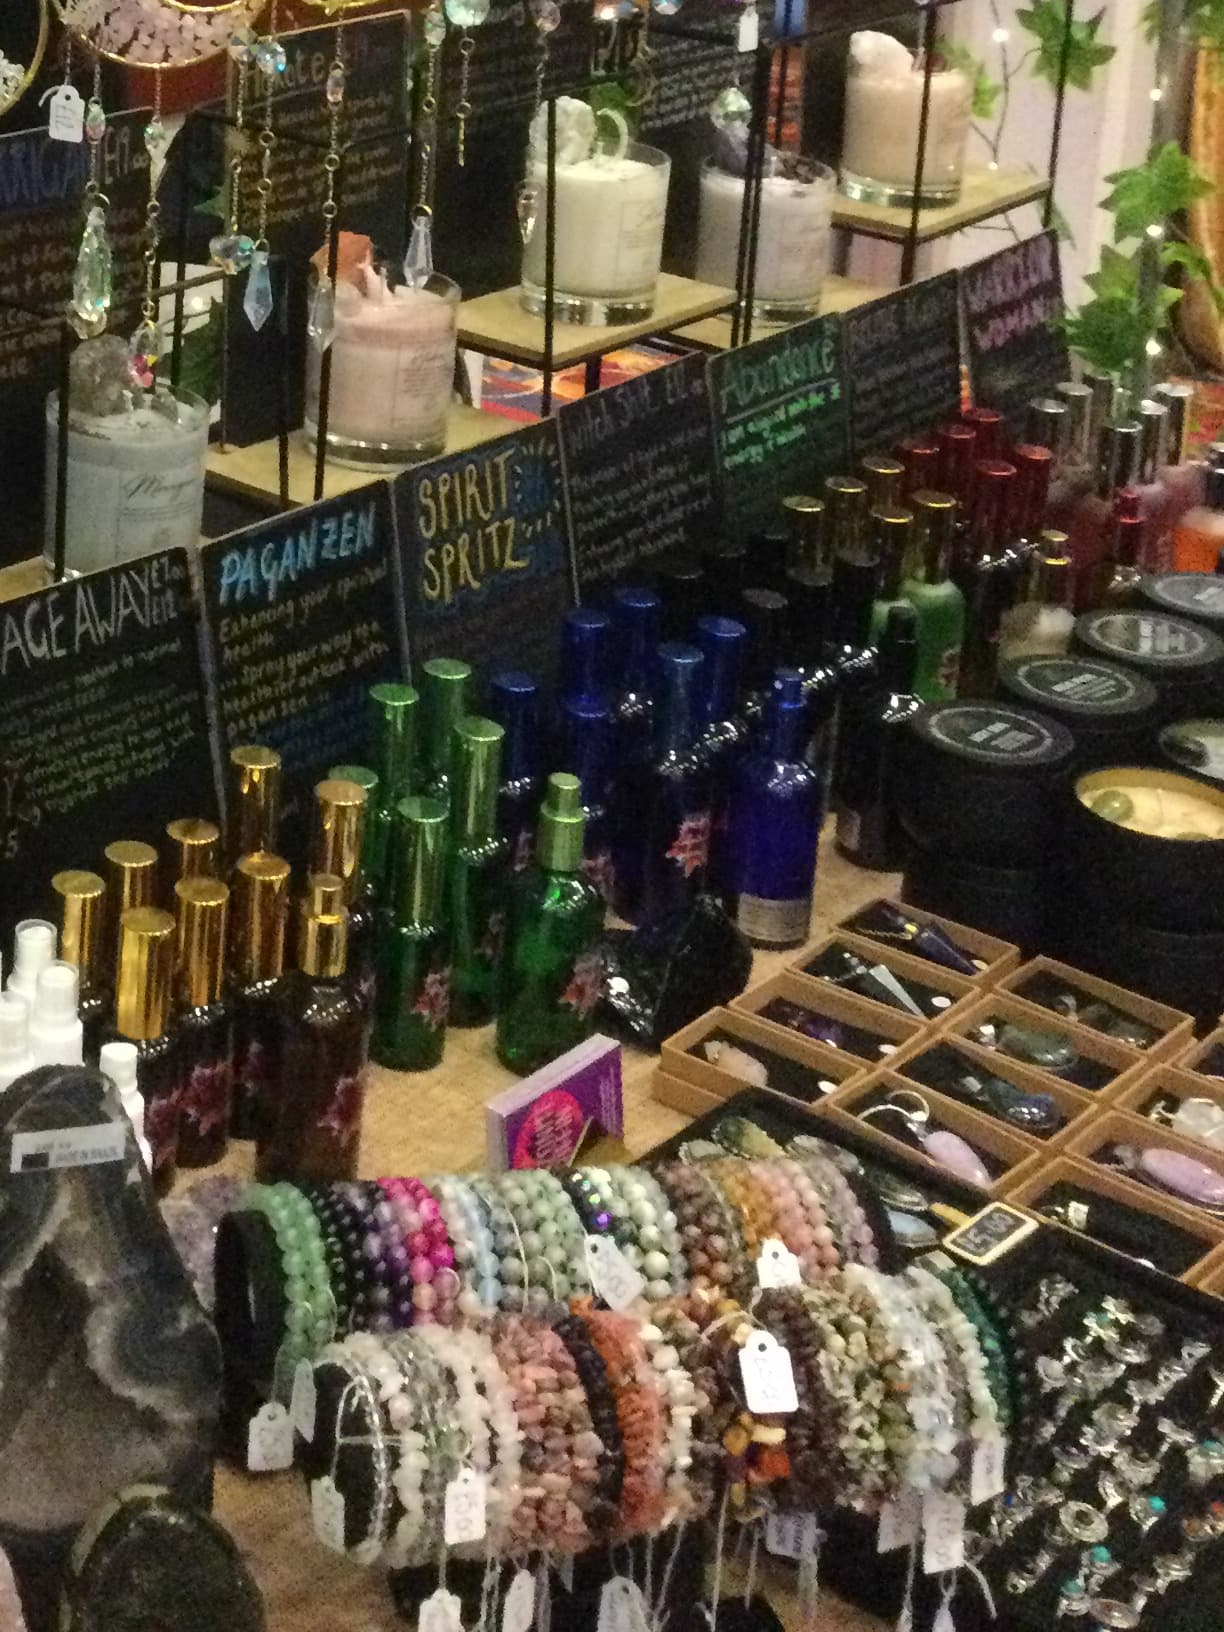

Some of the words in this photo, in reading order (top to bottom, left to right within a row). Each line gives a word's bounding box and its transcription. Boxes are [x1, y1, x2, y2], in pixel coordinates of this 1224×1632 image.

[418, 447, 516, 540] SPIRIT
[218, 518, 319, 607] PAGAN
[320, 500, 377, 560] ZEN
[423, 516, 531, 605] SPRITZ
